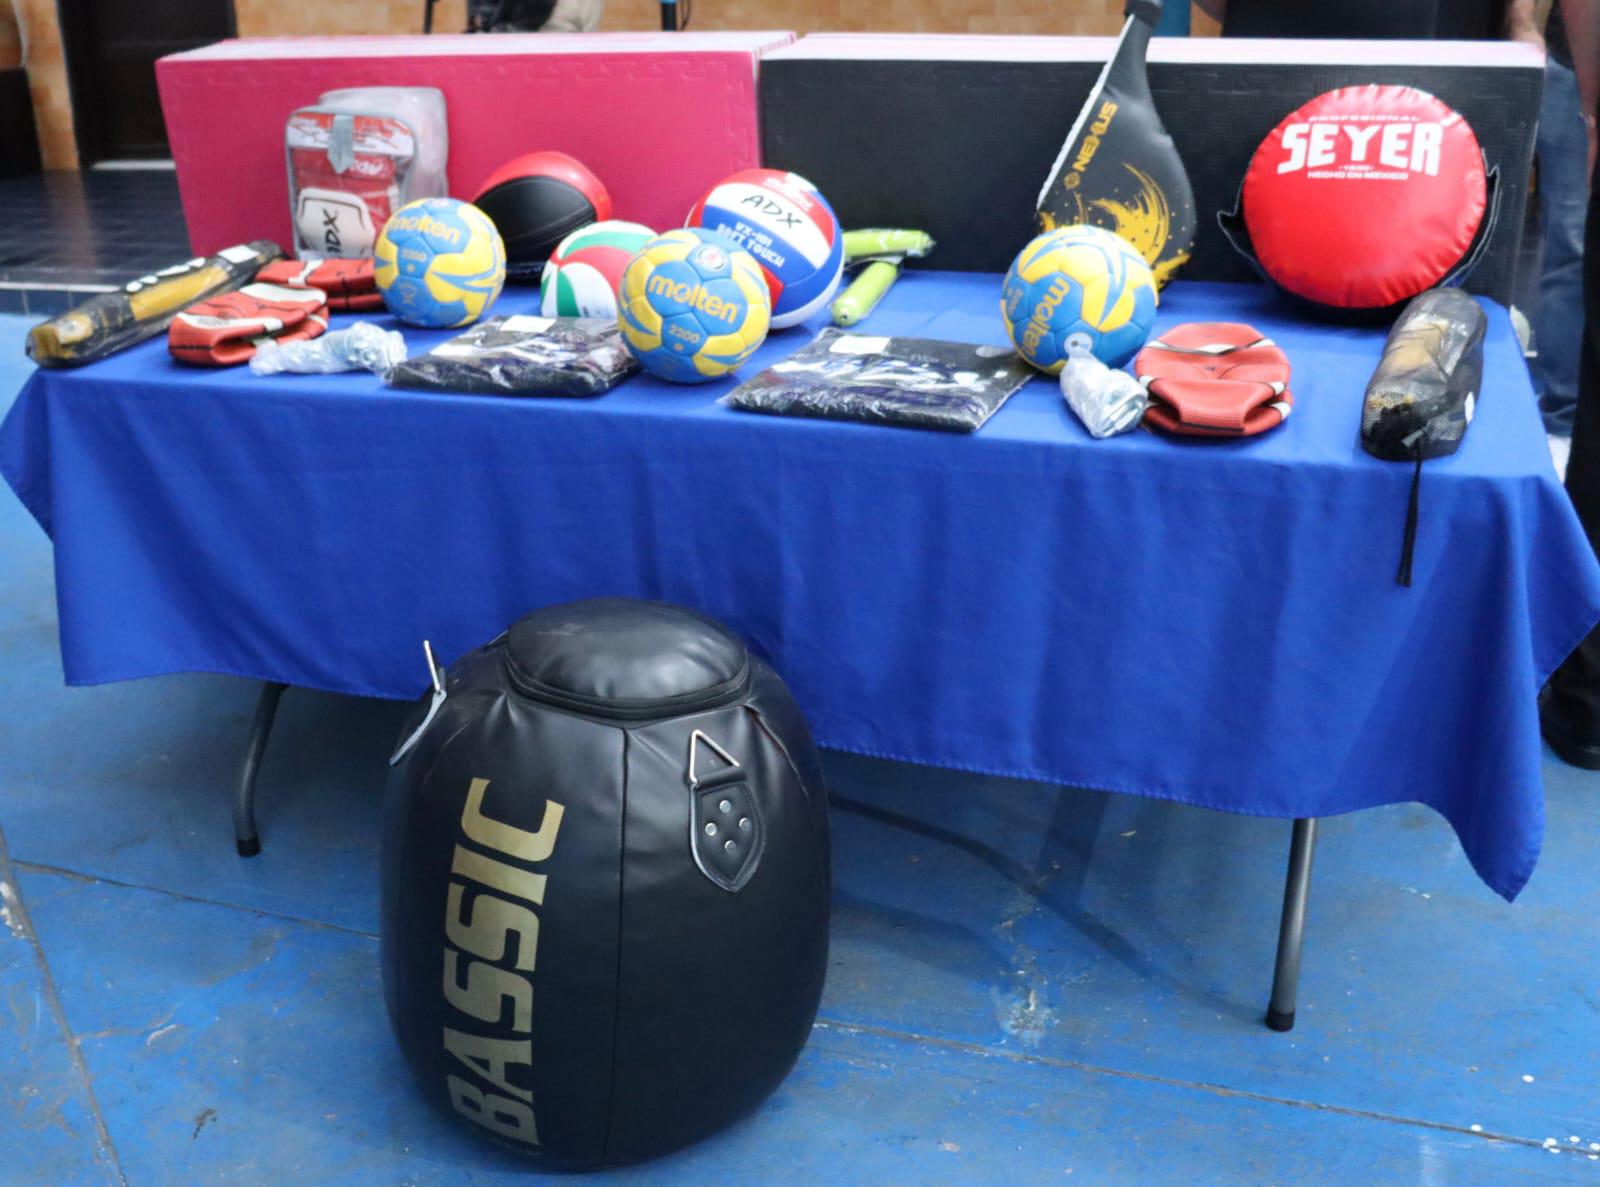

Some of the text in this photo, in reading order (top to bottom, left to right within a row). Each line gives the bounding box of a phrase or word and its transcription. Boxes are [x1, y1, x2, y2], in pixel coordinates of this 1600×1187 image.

[1073, 101, 1119, 171] NEXUS
[1277, 122, 1443, 176] SEYER
[388, 216, 461, 244] molten
[741, 194, 803, 229] ADX
[650, 275, 738, 323] molten
[1022, 276, 1070, 358] molten
[669, 324, 701, 344] 2200
[443, 776, 566, 1146] BASSIC
